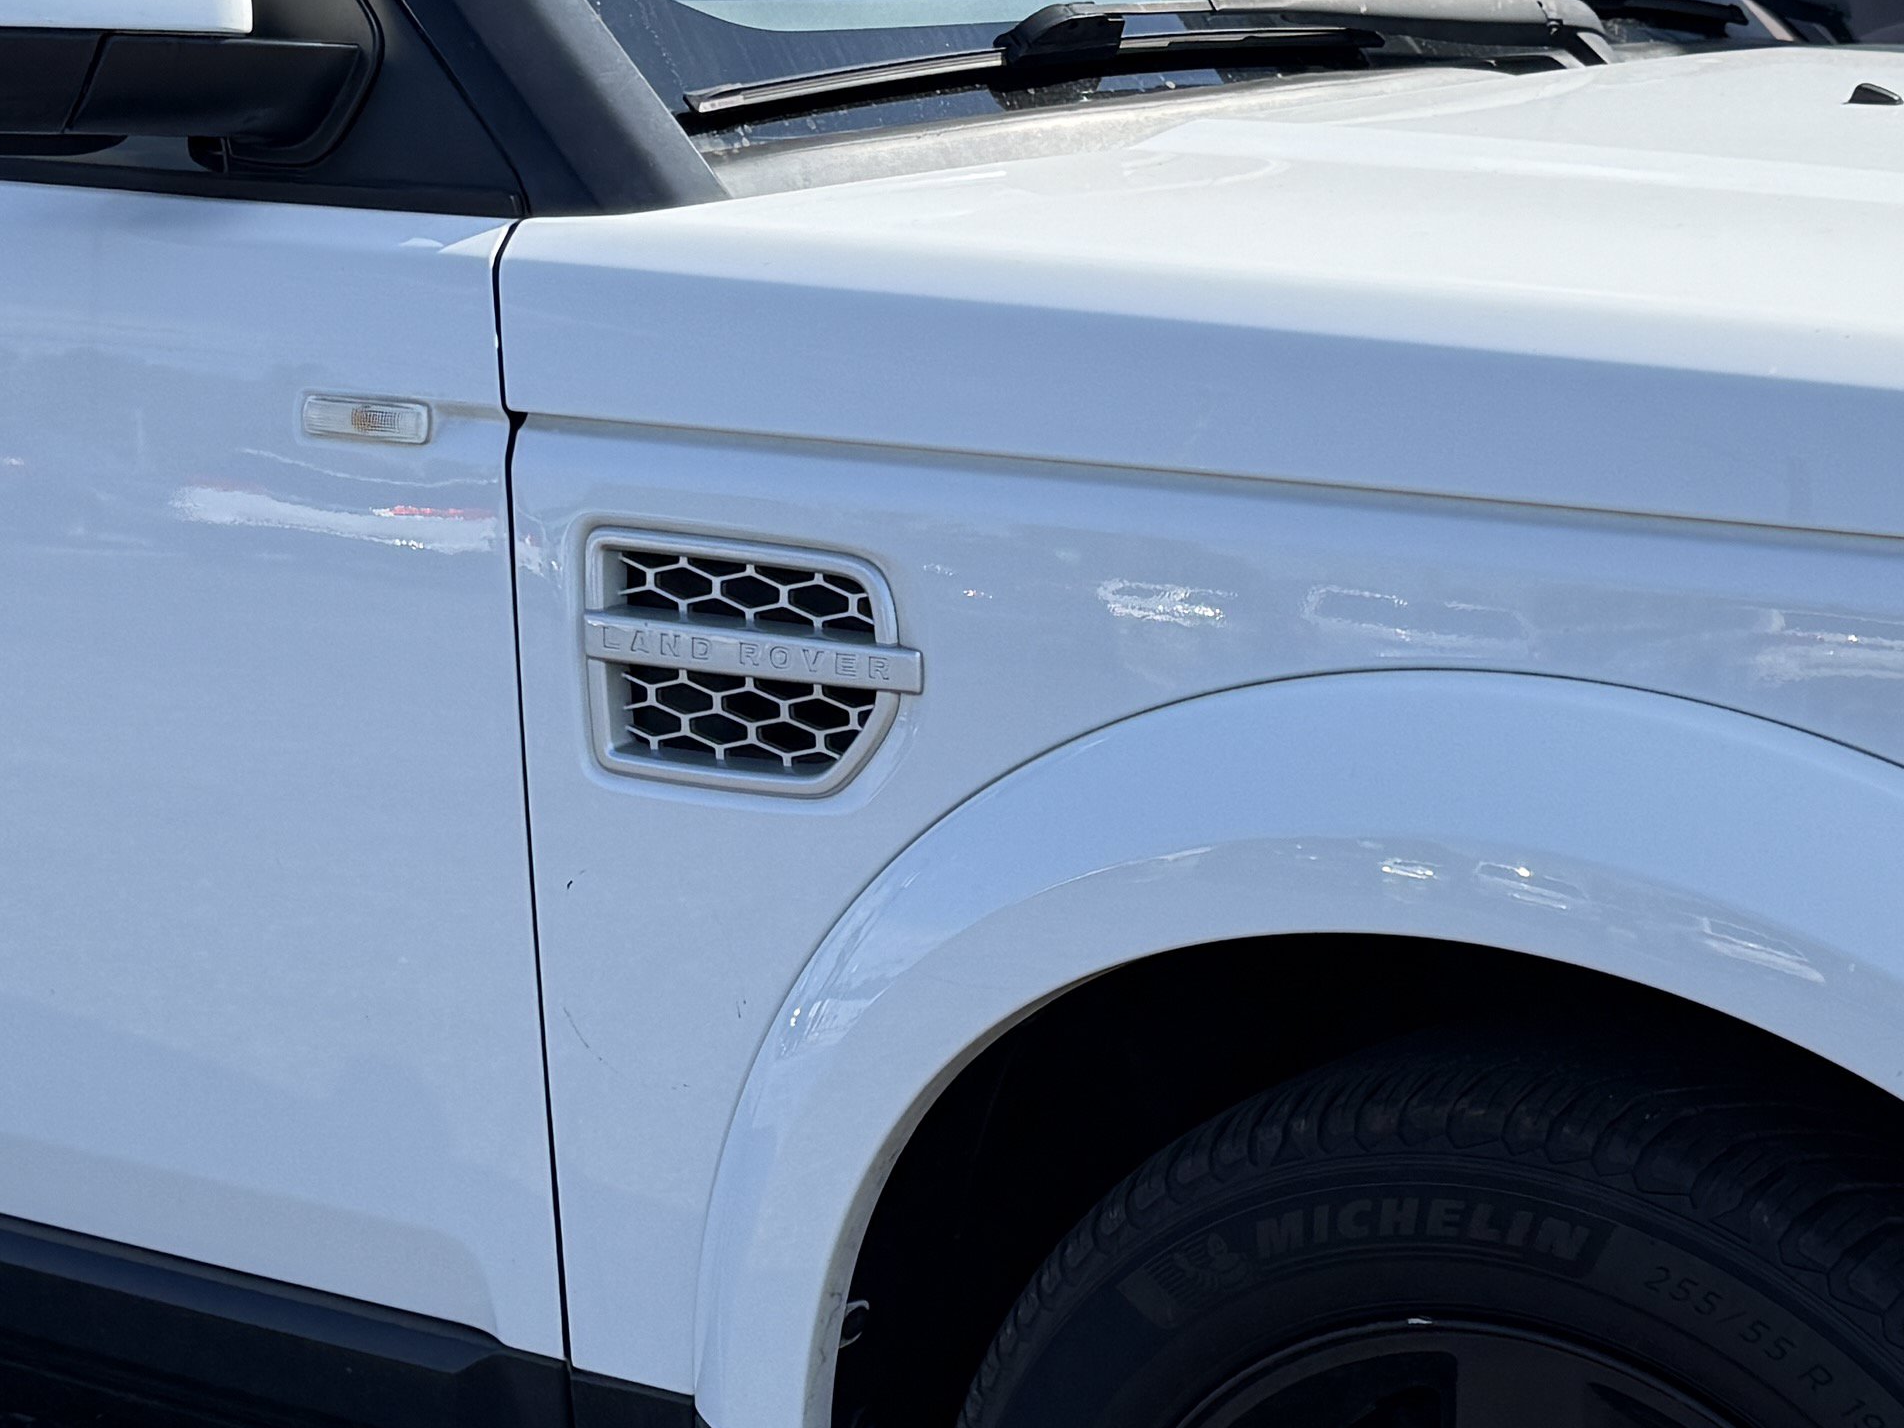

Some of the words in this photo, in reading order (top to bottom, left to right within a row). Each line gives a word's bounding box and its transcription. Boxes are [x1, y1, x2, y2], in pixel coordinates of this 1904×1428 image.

[601, 625, 714, 662] LAND
[738, 640, 892, 681] ROVER
[1255, 1197, 1592, 1262] MICHELIN
[1642, 1265, 1797, 1362] 255/55
[1797, 1362, 1834, 1393] R
